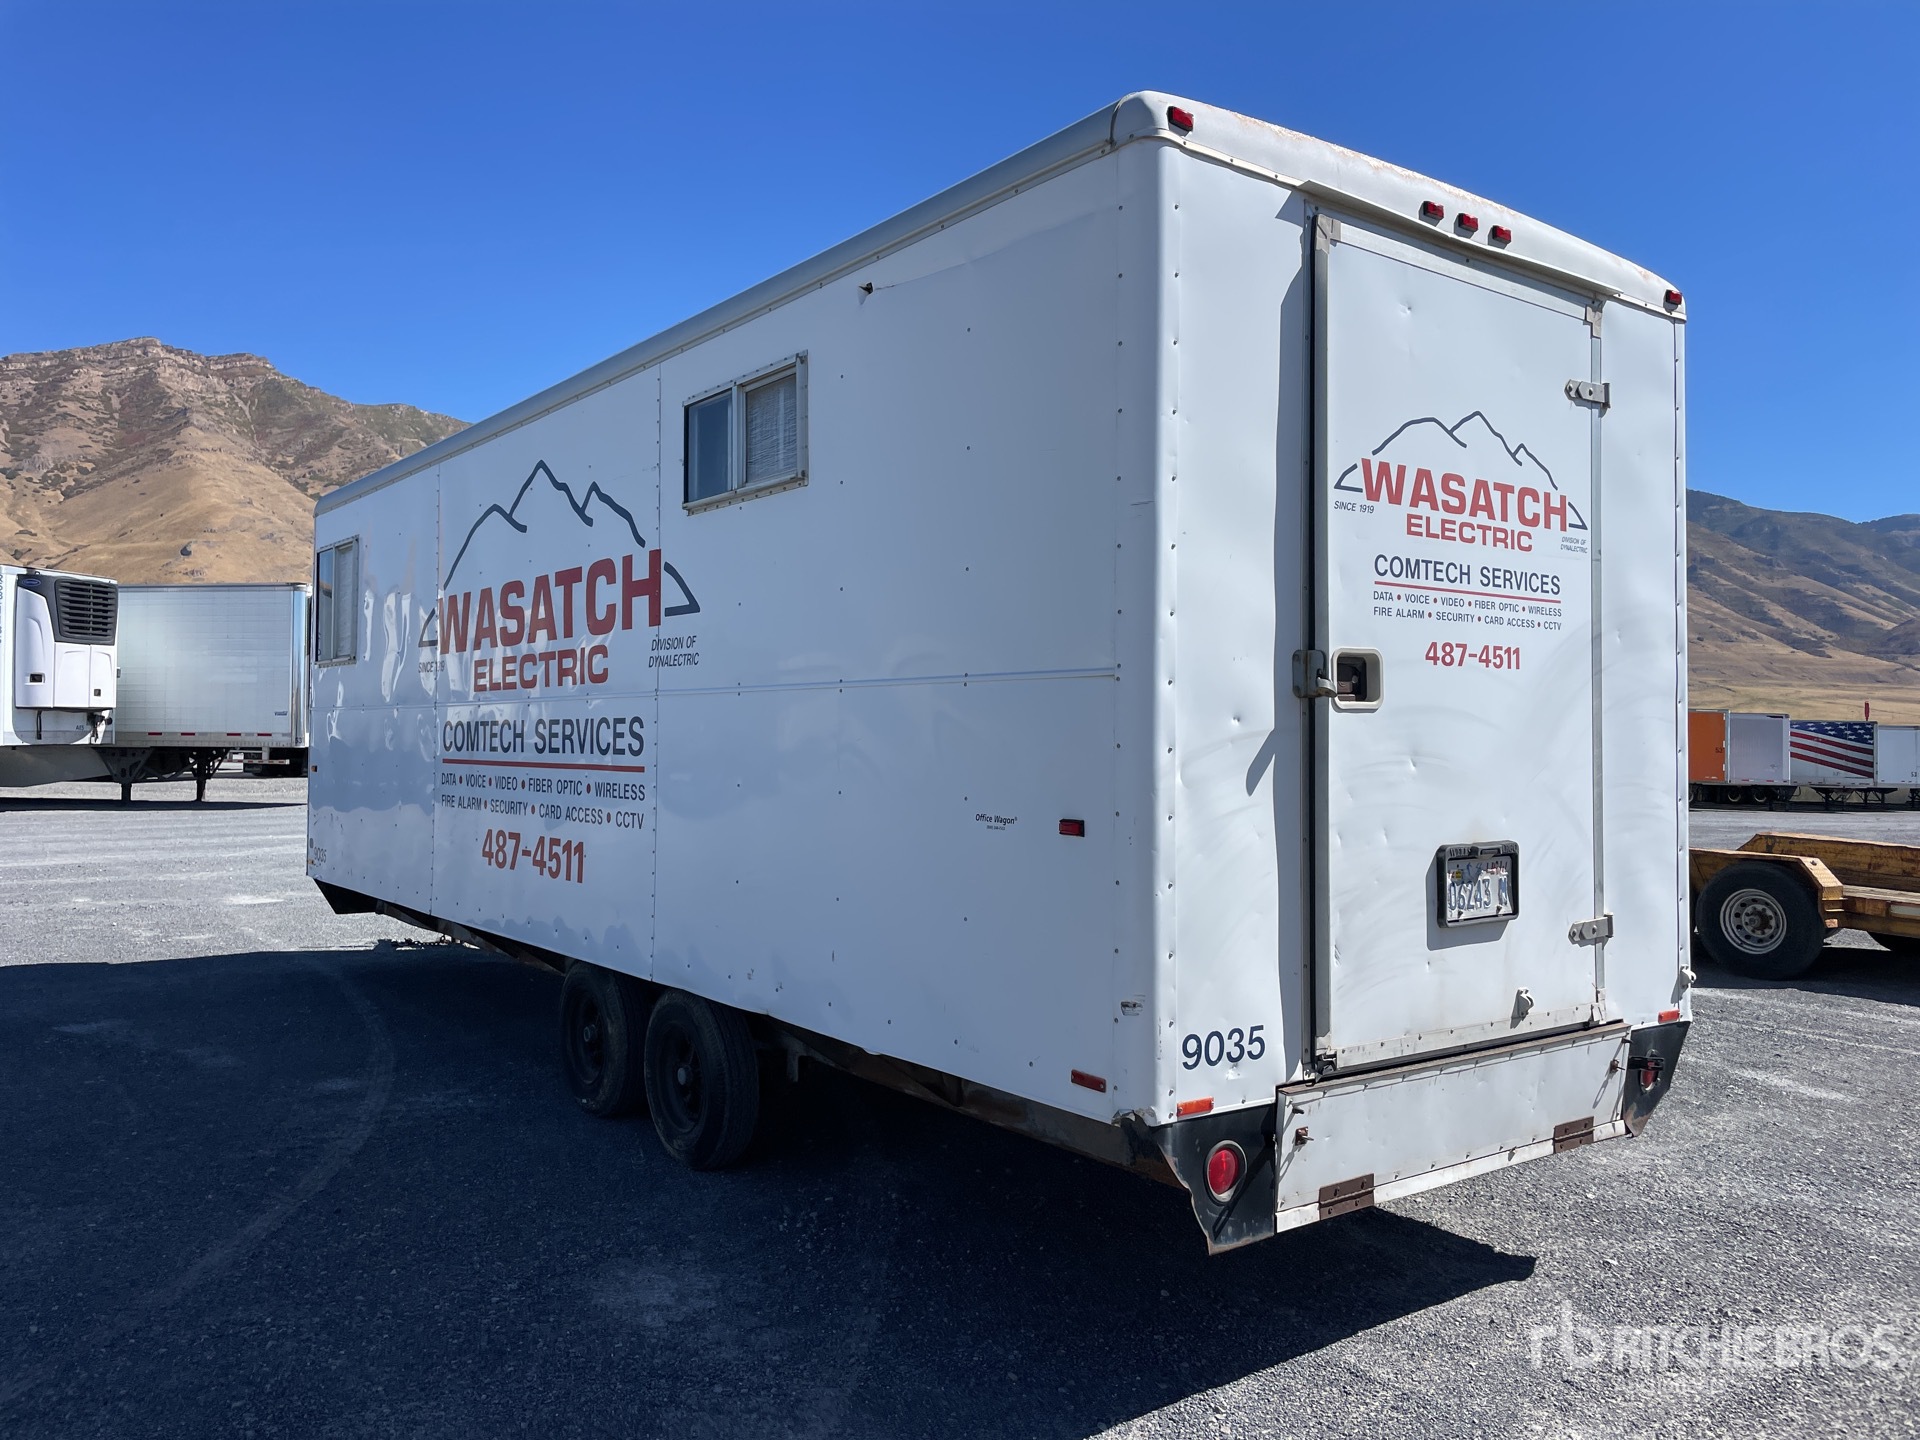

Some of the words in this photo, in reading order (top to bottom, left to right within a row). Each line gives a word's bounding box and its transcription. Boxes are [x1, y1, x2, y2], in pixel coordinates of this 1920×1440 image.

[1334, 500, 1356, 512] SINCE
[1359, 504, 1375, 514] 1919
[1361, 457, 1568, 532] WASATCH
[1406, 513, 1533, 552] ELECTRIC
[1374, 553, 1471, 585] COMTECH
[1479, 565, 1561, 596] SERVICES
[438, 548, 662, 655] WASATCH
[1373, 590, 1394, 602] DATA
[1404, 593, 1430, 605] VOICE
[1440, 596, 1465, 608] VIDEO
[1474, 599, 1496, 611] FIBER
[1498, 601, 1520, 613] OPTIC
[1528, 604, 1562, 618] WIRELESS
[1373, 606, 1393, 617] FIRE
[1395, 608, 1425, 619] ALARM
[1435, 611, 1475, 624] SECURITY
[1484, 615, 1505, 626] CARD
[1506, 617, 1536, 629] ACCESS
[1543, 620, 1562, 631] CCTV
[648, 652, 700, 668] DYNALECTRIC
[651, 640, 684, 651] DIVISION
[686, 635, 697, 647] OF
[1425, 641, 1521, 670] 487-4511
[473, 644, 609, 692] ELECTRIC
[442, 719, 525, 753] COMTECH
[534, 716, 645, 757] SERVICES
[441, 773, 457, 786] DATA
[465, 774, 487, 788] VOICE
[494, 776, 518, 791] VIDEO
[528, 777, 553, 794] FIBER
[556, 778, 583, 796] OPTIC
[594, 781, 646, 801] WIRELESS
[441, 794, 456, 808] FIRE
[457, 796, 482, 811] ALARM
[490, 798, 529, 816] SECURITY
[538, 803, 562, 820] CARD
[564, 808, 603, 825] ACCESS
[615, 811, 644, 830] CCTV
[975, 813, 993, 822] Office
[482, 828, 585, 884] 487-4511
[1182, 1024, 1266, 1071] 9035
